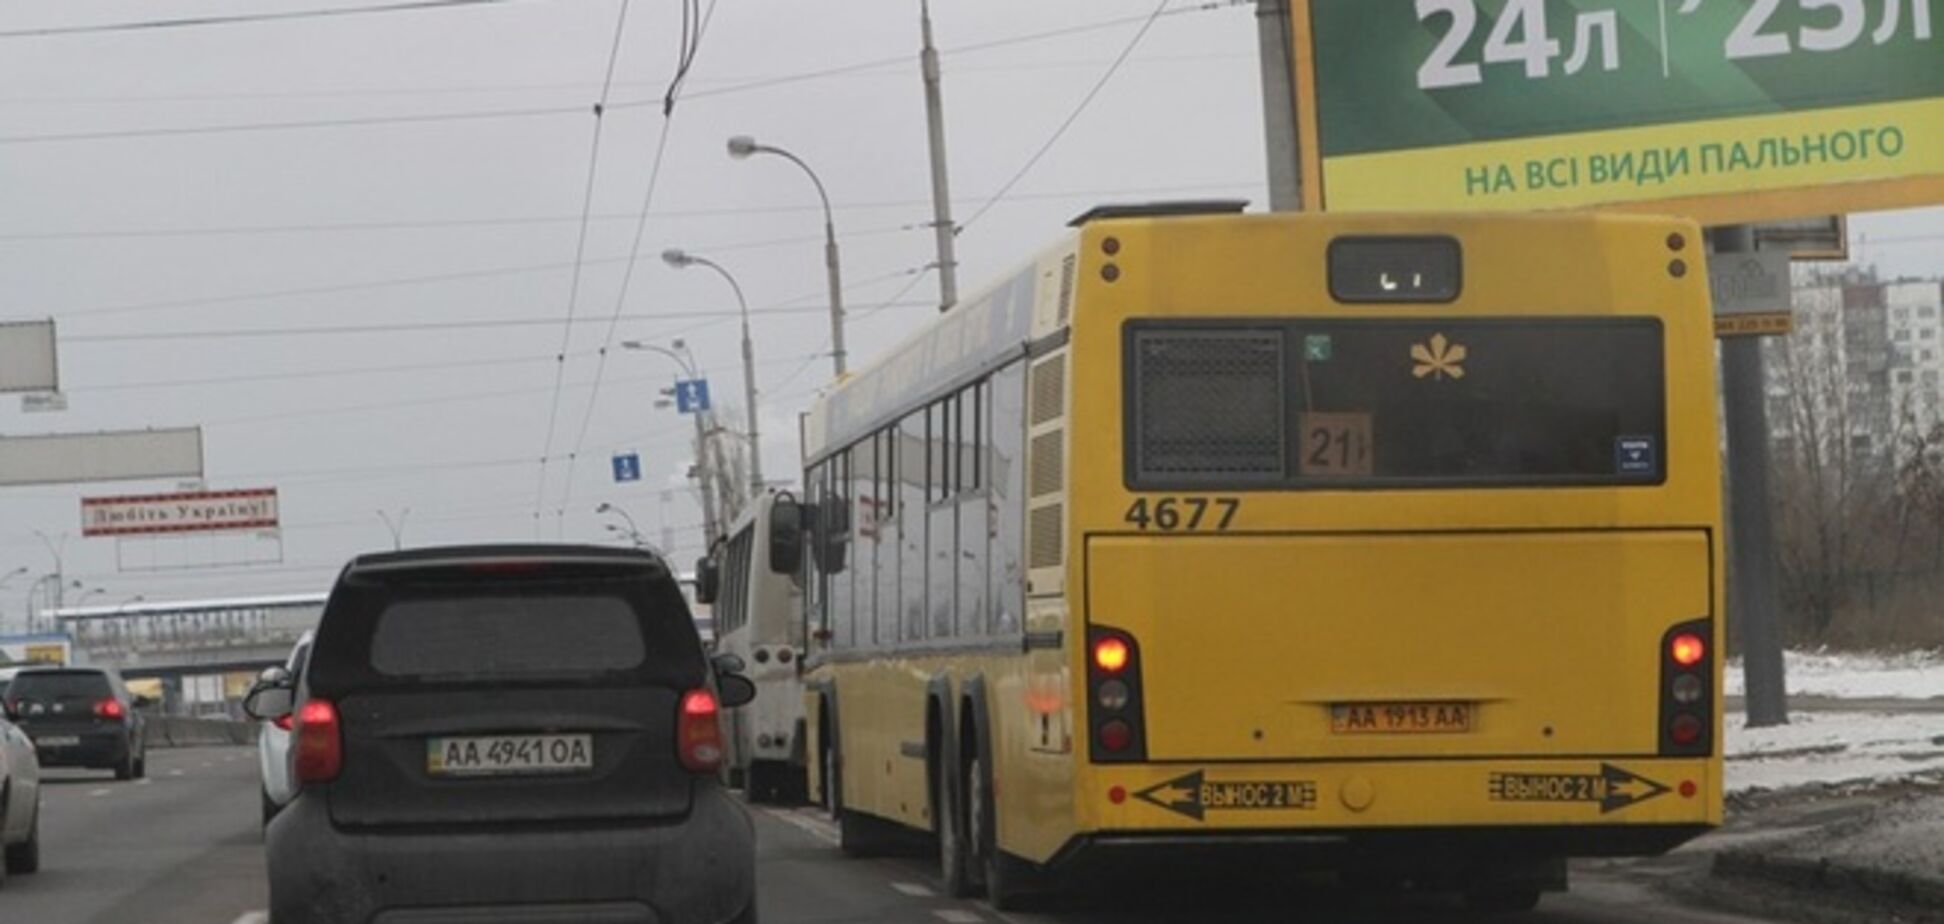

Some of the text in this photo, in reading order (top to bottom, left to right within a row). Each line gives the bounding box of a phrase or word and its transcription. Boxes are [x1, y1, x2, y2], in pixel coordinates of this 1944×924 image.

[1464, 126, 1905, 196] НА ВСІ ВИДИ ПАЛЬНОГО
[1125, 497, 1240, 531] 4677
[486, 739, 544, 765] 4941
[1201, 782, 1270, 806] ВЫНОС
[1272, 783, 1283, 806] 2
[1504, 776, 1574, 800] ВЫНОС
[1577, 777, 1588, 800] 2
